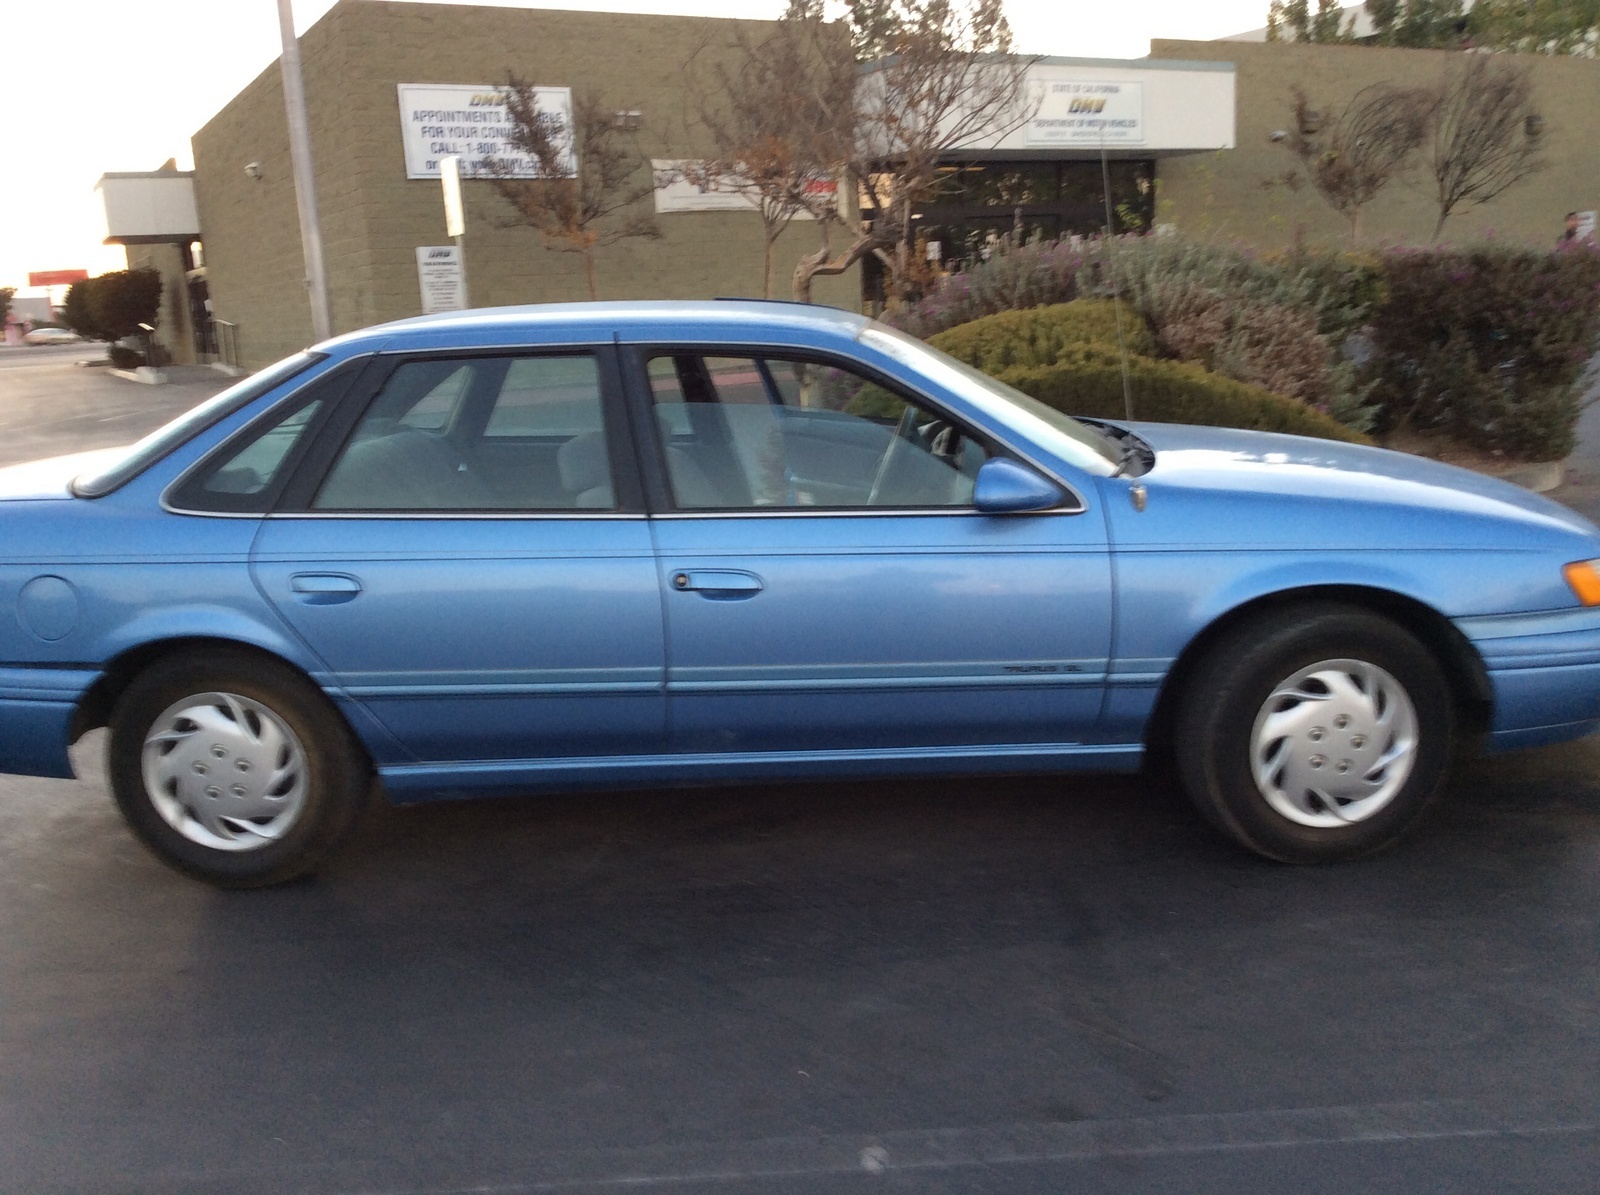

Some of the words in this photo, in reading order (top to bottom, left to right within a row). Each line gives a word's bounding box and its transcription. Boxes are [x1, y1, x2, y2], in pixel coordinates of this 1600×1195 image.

[1067, 98, 1107, 113] DMV
[412, 110, 501, 123] APPOINTMENTS
[1035, 119, 1076, 128] DEPARTMENT
[421, 126, 444, 139] FOR
[447, 126, 478, 139] YOUR
